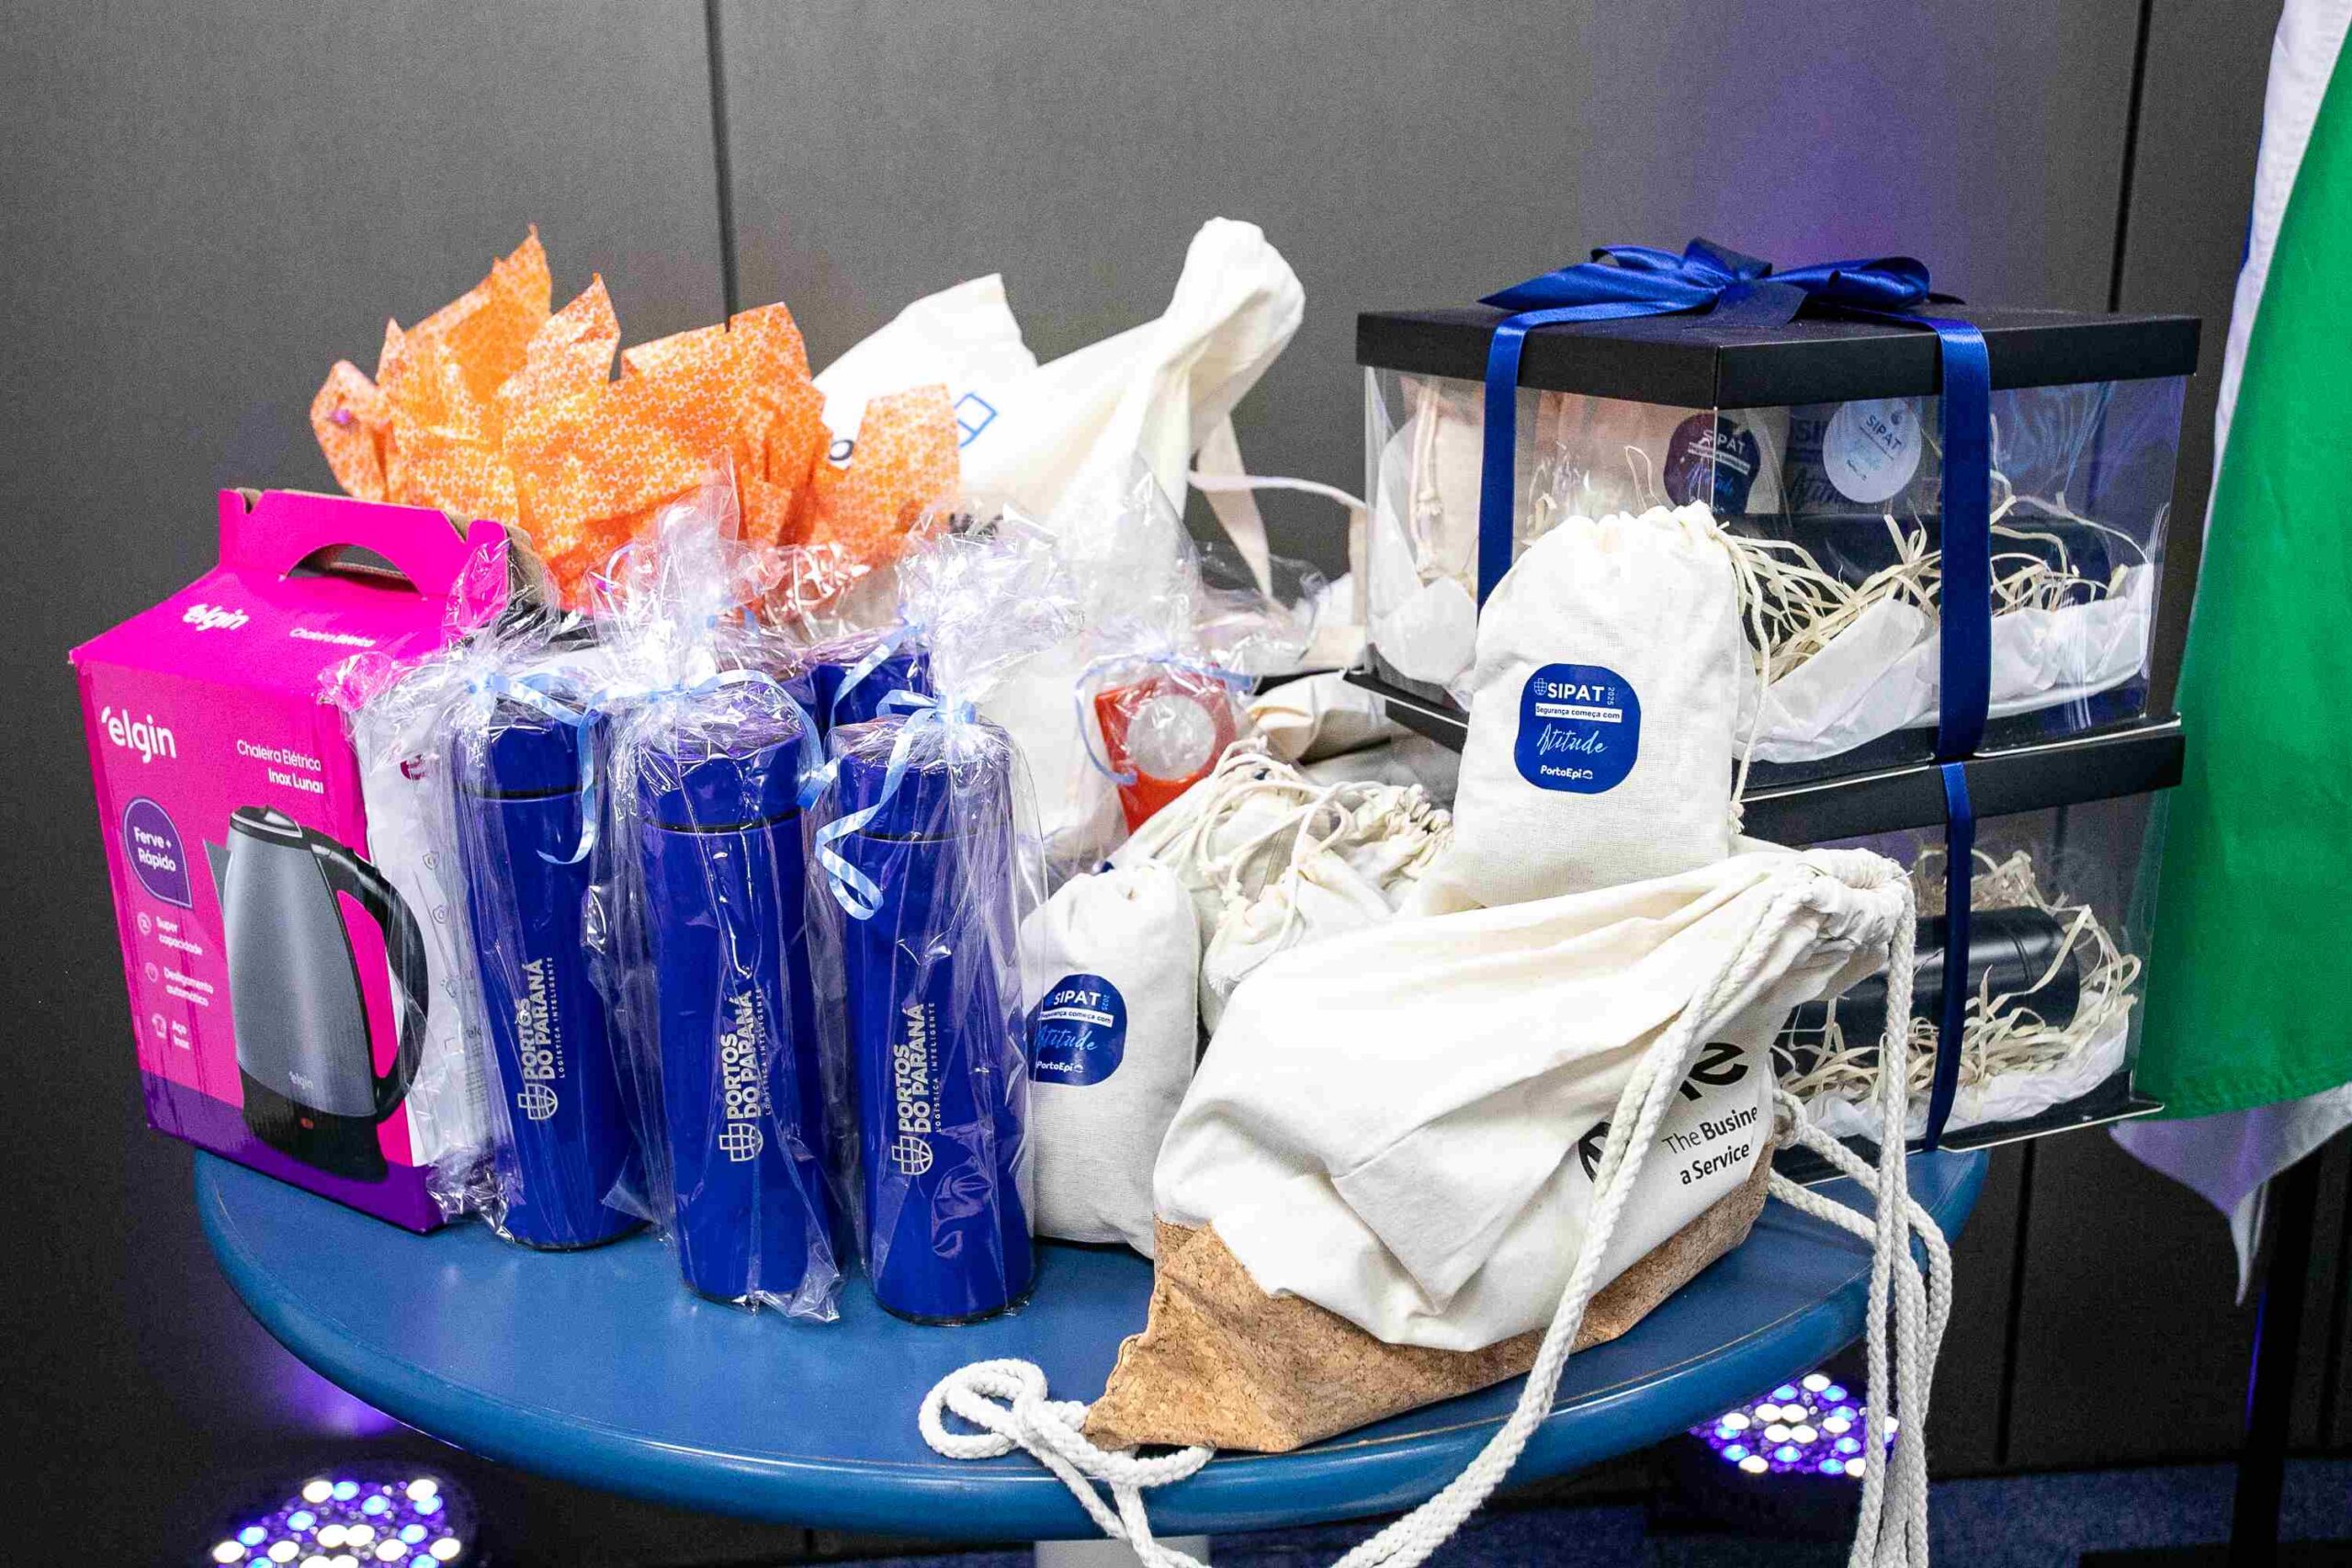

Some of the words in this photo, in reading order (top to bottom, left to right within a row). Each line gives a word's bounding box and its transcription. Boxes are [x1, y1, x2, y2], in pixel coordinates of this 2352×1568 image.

[1867, 414, 1902, 450] SIPAT
[183, 603, 250, 632] elgin
[1547, 682, 1604, 702] SIPAT
[1536, 705, 1569, 716] Segurança
[1571, 709, 1600, 718] começa
[1537, 723, 1608, 756] Atitude
[237, 739, 281, 762] Chaleira
[283, 749, 322, 772] Elétrica
[268, 768, 292, 787] Inox
[1540, 765, 1583, 780] PortoEpi
[133, 827, 164, 847] Ferve
[138, 848, 176, 872] Rápido
[522, 958, 551, 1045] PARANÁ
[1053, 990, 1101, 1007] SIPAT
[1068, 1011, 1095, 1020] começa
[518, 998, 539, 1080] PORTOS
[729, 990, 759, 1082] PARANÁ
[902, 1003, 930, 1095] PARANÁ
[929, 1002, 939, 1072] INTELIGENTE
[288, 1071, 314, 1089] elgin
[537, 1054, 556, 1079] DO
[720, 1033, 743, 1119] PORTOS
[742, 1087, 761, 1118] DO
[894, 1044, 914, 1133] PORTOS
[912, 1105, 932, 1134] DO
[1662, 1129, 1702, 1154] The
[1679, 1169, 1691, 1185] a
[1692, 1144, 1750, 1179] Service
